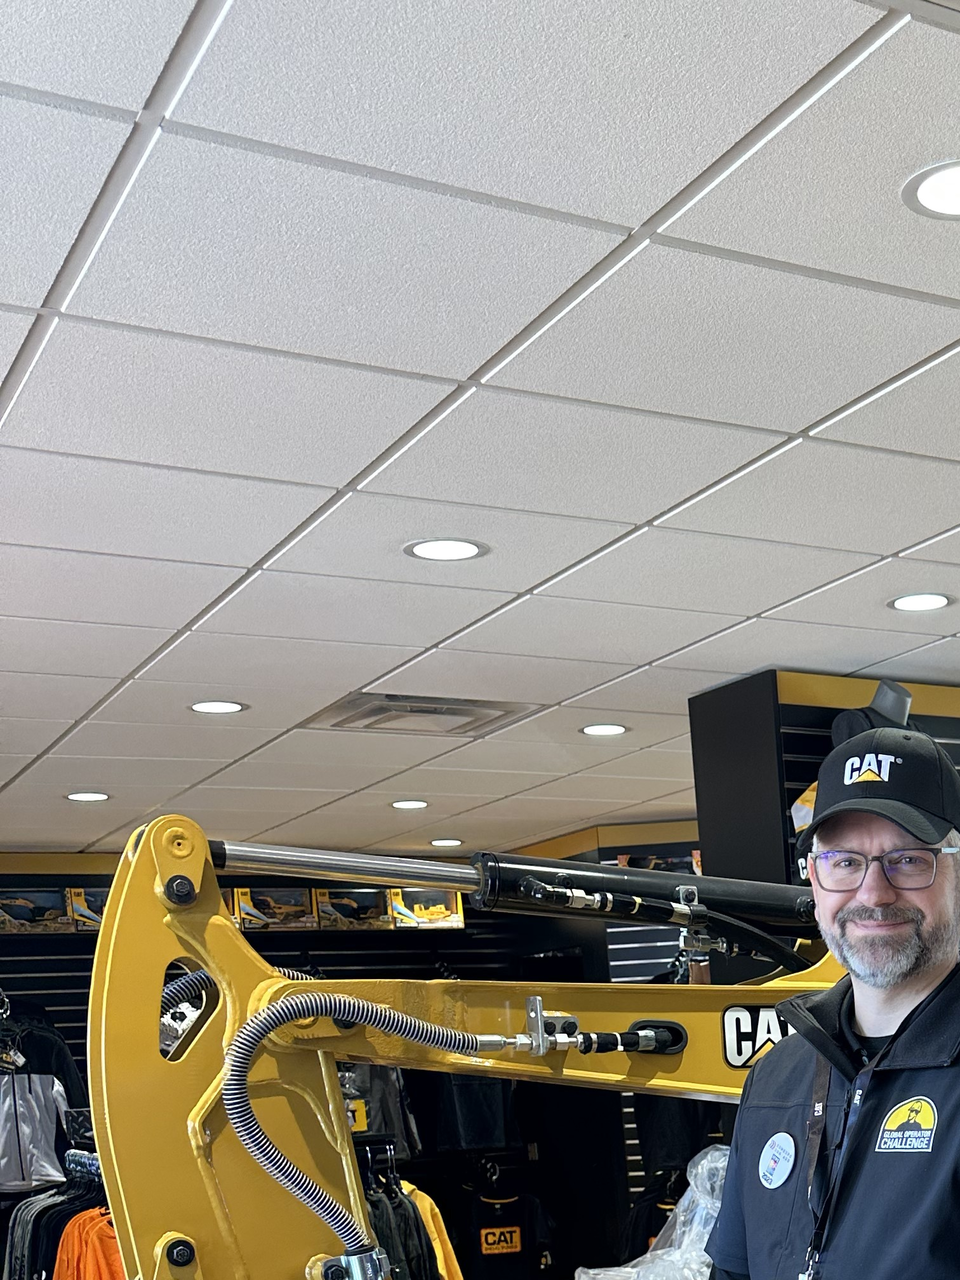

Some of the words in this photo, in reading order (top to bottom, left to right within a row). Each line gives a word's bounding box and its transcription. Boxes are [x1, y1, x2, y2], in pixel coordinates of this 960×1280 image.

[844, 753, 895, 785] CAT
[724, 1007, 792, 1067] CA
[904, 1130, 932, 1138] OPERATOR
[880, 1137, 930, 1149] CHALLENGE
[485, 1230, 517, 1246] CAT
